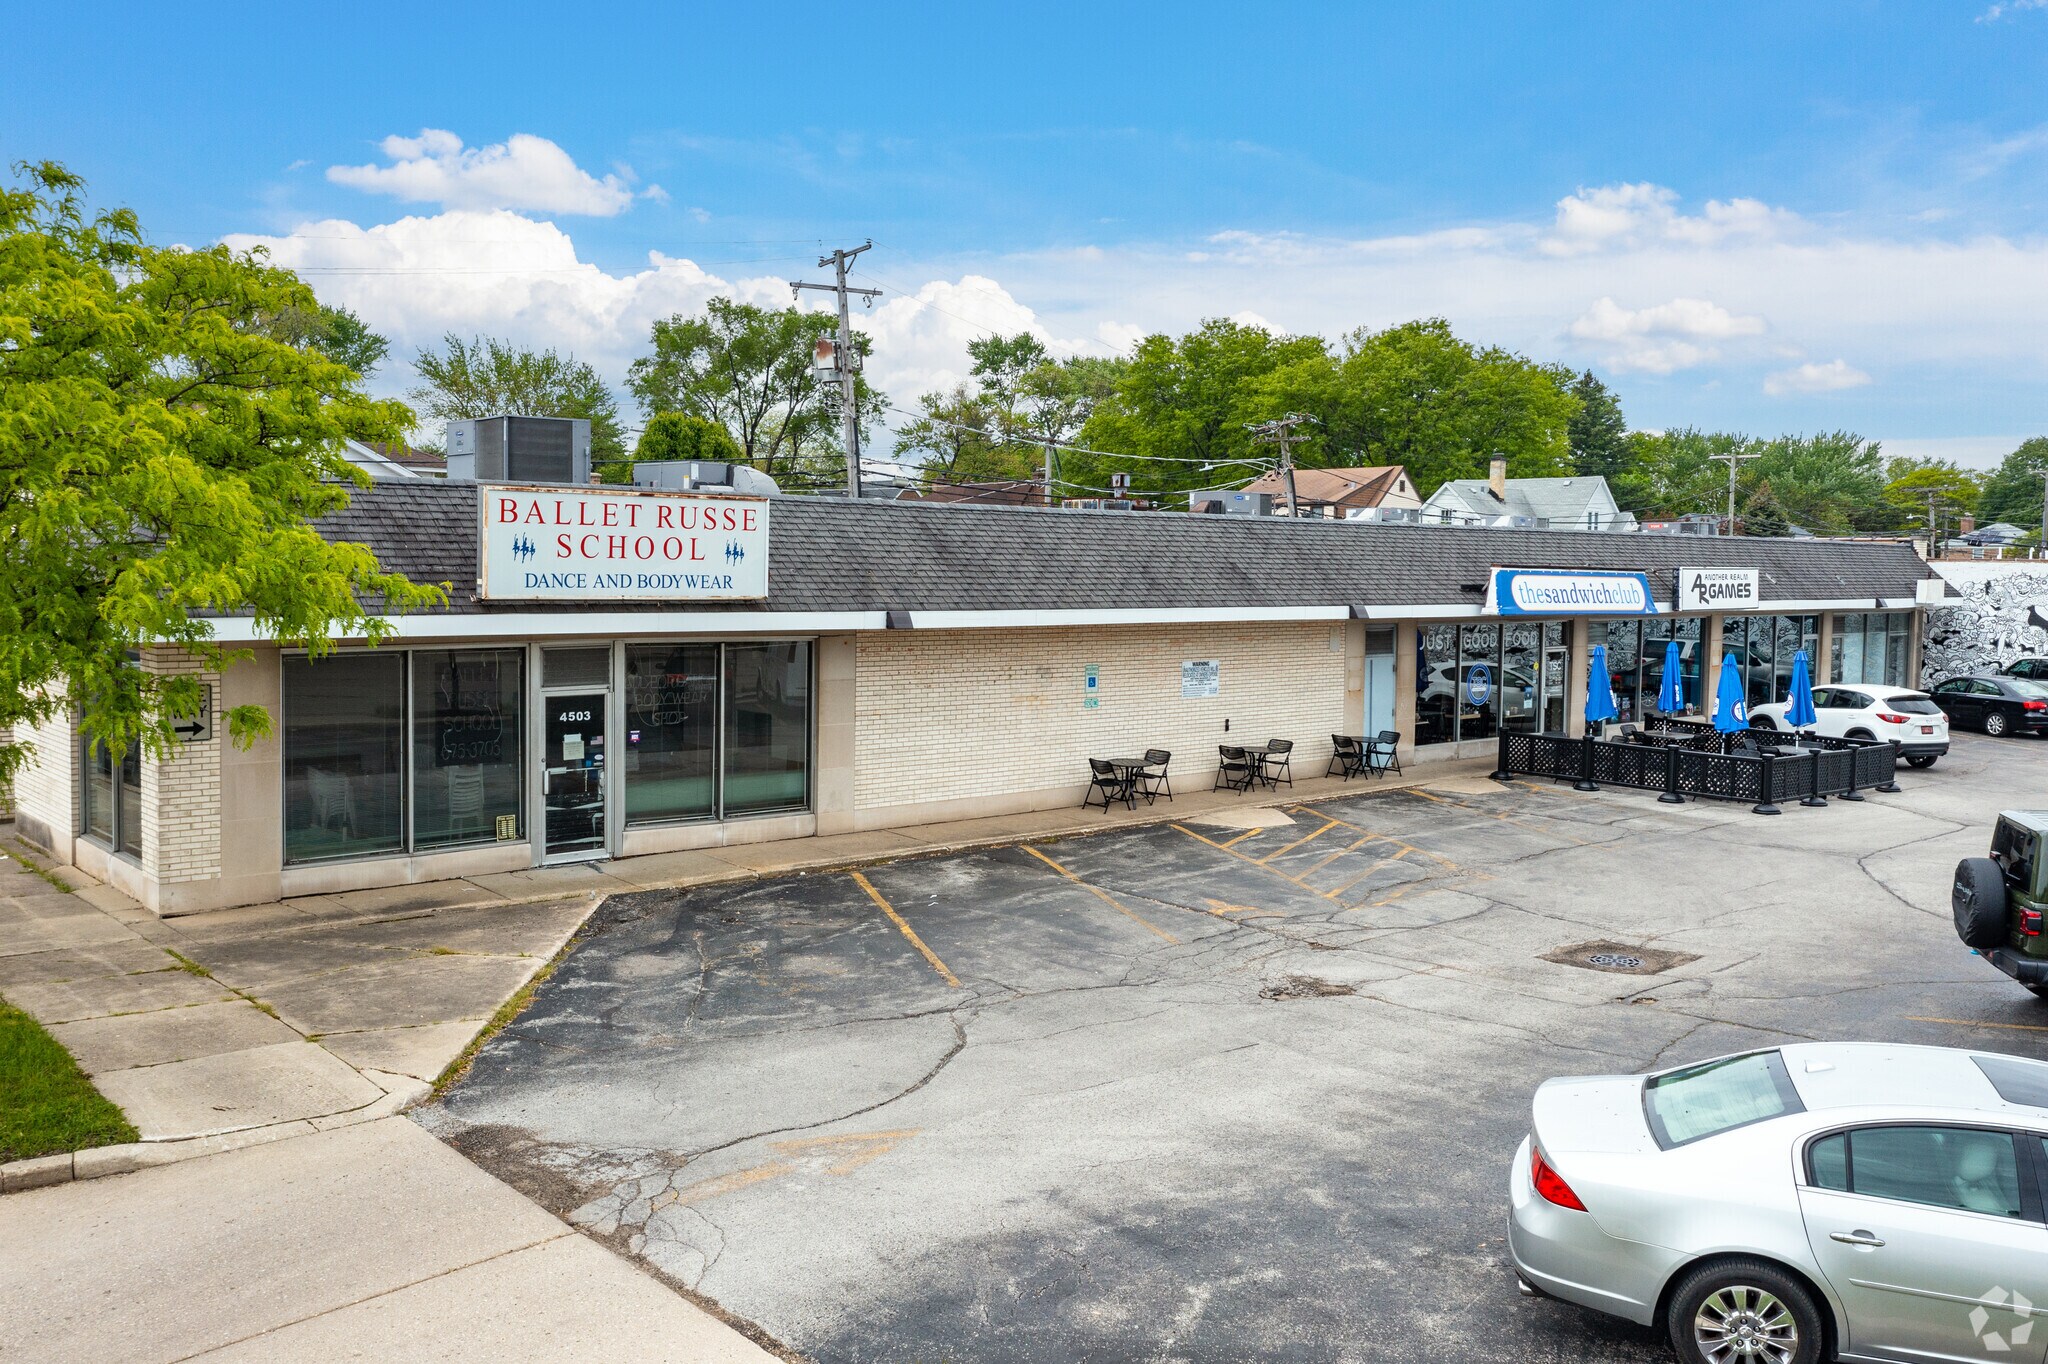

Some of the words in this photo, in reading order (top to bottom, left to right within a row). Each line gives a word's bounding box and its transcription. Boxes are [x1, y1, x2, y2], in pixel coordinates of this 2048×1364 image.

[498, 498, 643, 528] BALLET
[656, 504, 758, 532] RUSSE
[556, 533, 706, 562] SCHOOL
[524, 572, 587, 589] DANCE
[592, 573, 632, 589] AND
[637, 573, 733, 590] BODYWEAR
[1704, 573, 1729, 581] ANOTHER
[1730, 573, 1749, 581] REALM
[1518, 581, 1641, 605] thesandwichclub
[1708, 583, 1751, 599] GAMES
[1419, 633, 1452, 651] JUST
[1463, 633, 1498, 649] GOOD
[1549, 661, 1562, 671] TSC
[443, 715, 500, 732] SCHOOL
[559, 710, 592, 722] 4503
